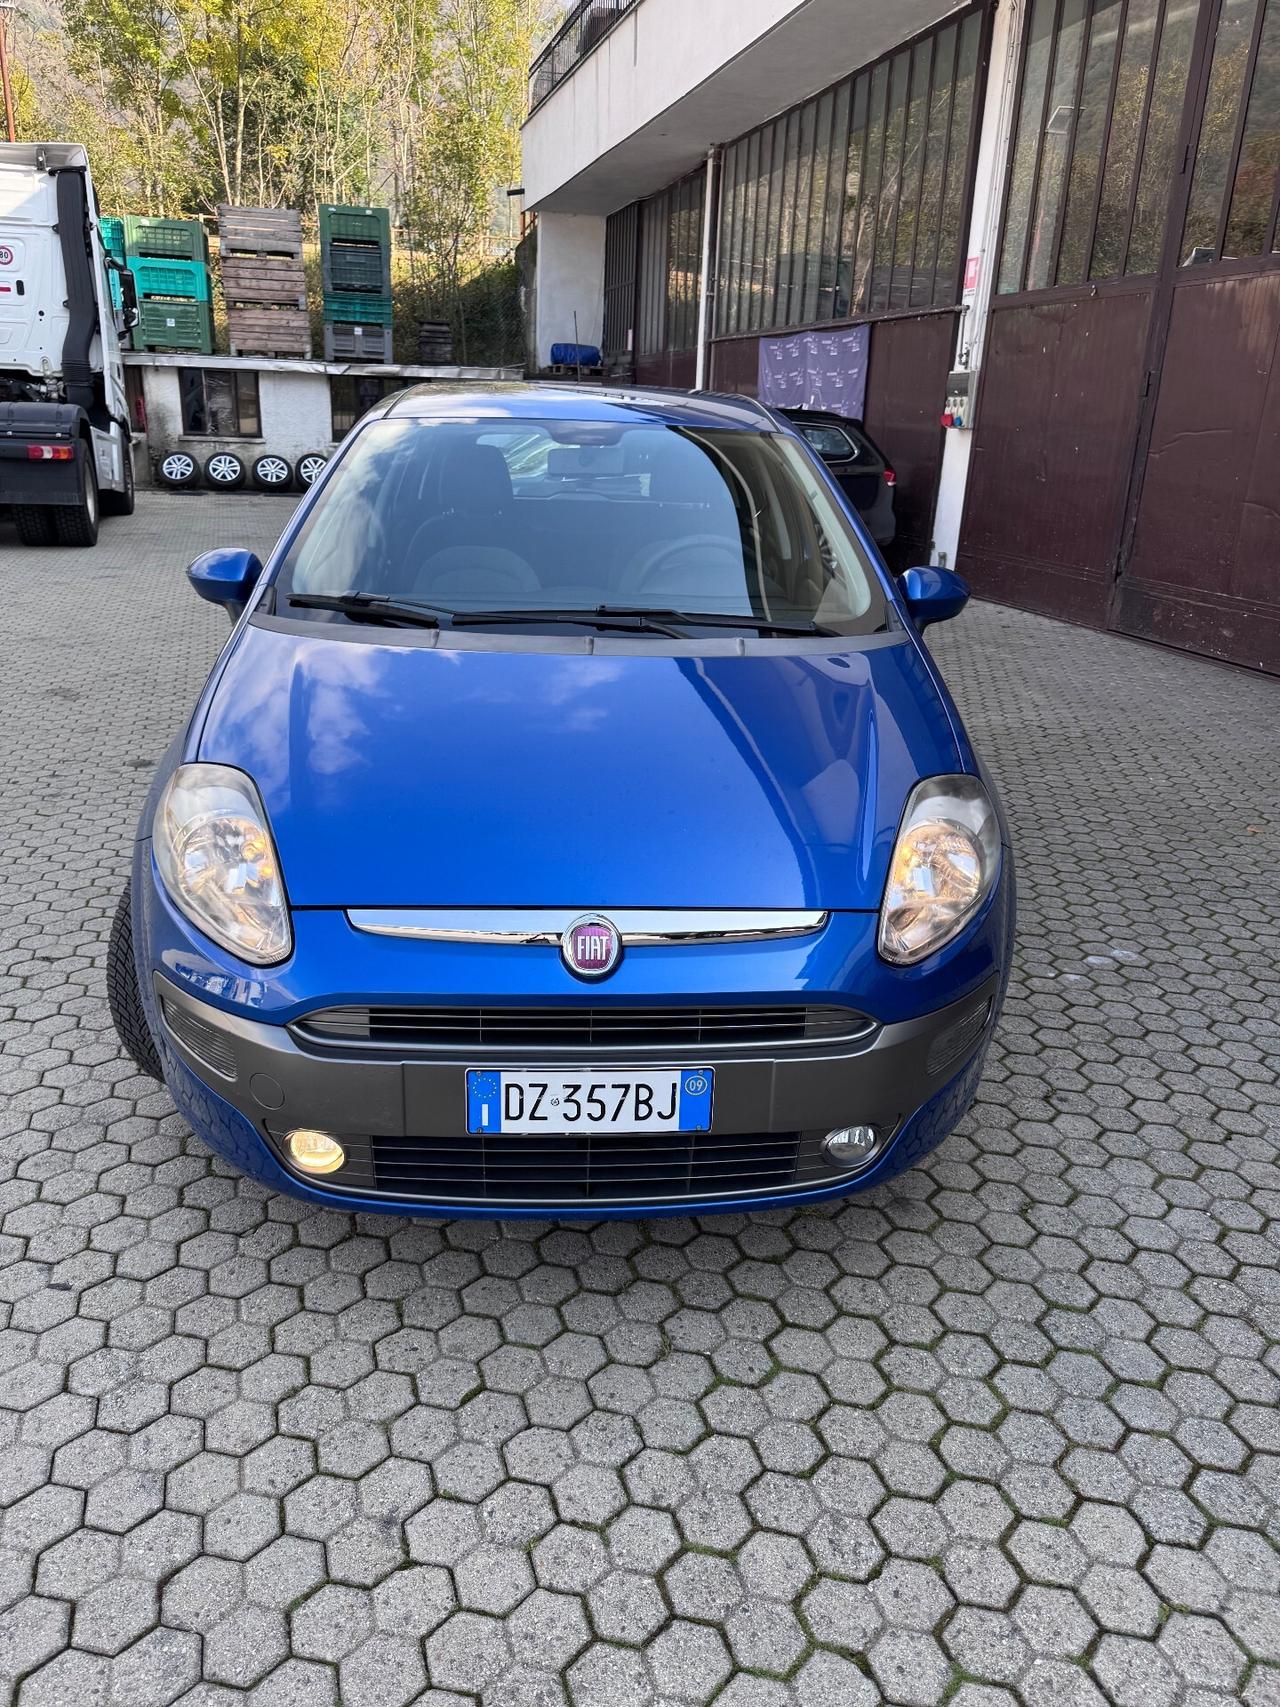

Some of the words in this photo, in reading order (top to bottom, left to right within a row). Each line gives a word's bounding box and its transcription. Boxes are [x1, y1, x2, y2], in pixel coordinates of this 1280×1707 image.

[577, 935, 610, 961] FIAT
[689, 1079, 703, 1092] 09
[504, 1082, 548, 1121] DZ
[562, 1082, 678, 1122] 357BJ
